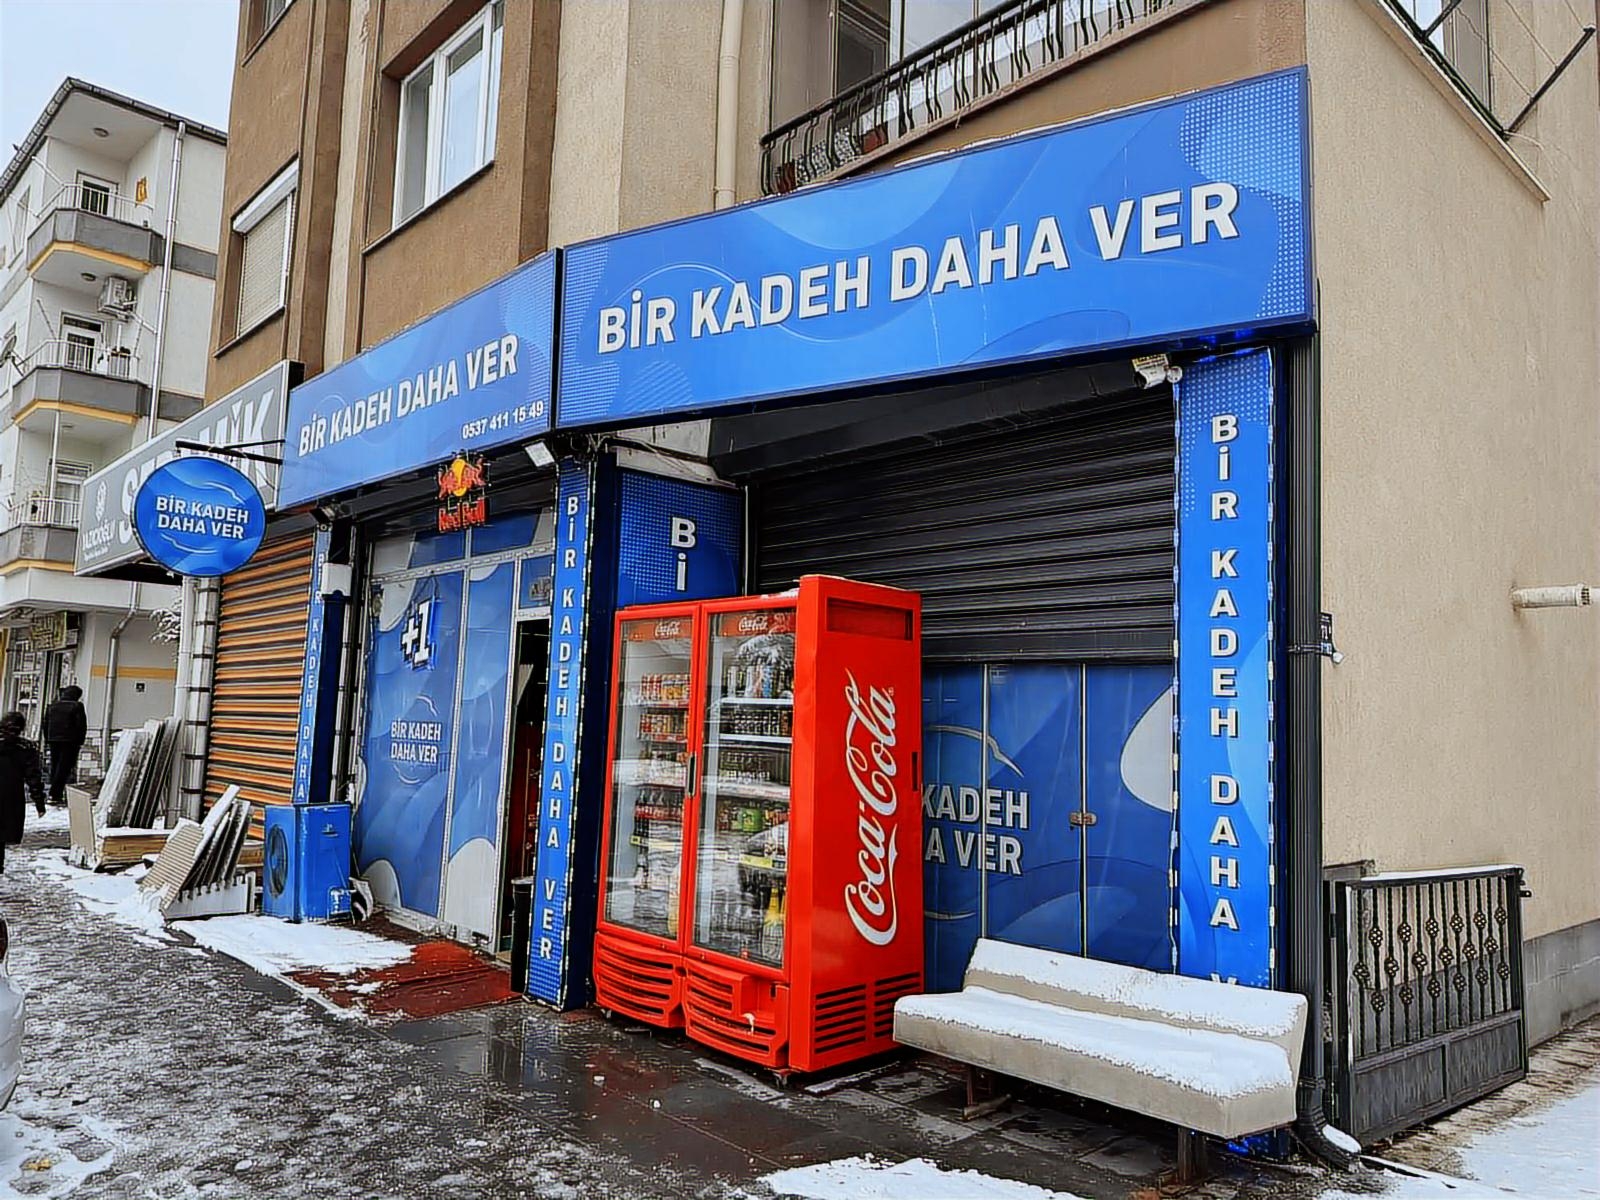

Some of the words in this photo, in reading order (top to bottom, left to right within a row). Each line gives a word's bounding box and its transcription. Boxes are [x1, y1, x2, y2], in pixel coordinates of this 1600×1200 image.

[598, 289, 676, 354] BİR
[691, 256, 870, 338] KADEH
[891, 215, 1070, 301] DAHA
[1090, 182, 1240, 261] VER
[299, 413, 327, 457] BİR
[330, 387, 393, 444] KADEH
[397, 359, 459, 417] DAHA
[466, 334, 518, 391] VER
[462, 418, 488, 439] 0537
[489, 411, 509, 430] 411
[513, 406, 526, 424] 15
[528, 400, 544, 418] 49
[1211, 414, 1239, 520] BİR
[156, 494, 187, 515] BİR
[191, 502, 249, 524] KADEH
[158, 513, 206, 534] DAHA
[211, 521, 244, 539] VER
[564, 496, 579, 568] BİR
[305, 618, 319, 708] KADEH
[556, 589, 575, 716] KADEH
[1209, 550, 1239, 737] KADEH
[298, 725, 310, 799] DAHA
[391, 718, 407, 738] BİR
[408, 722, 441, 741] KADEH
[391, 742, 416, 761] DAHA
[418, 744, 438, 763] VER
[547, 742, 565, 849] DAHA
[845, 667, 898, 946] Coca-Cola
[922, 784, 1028, 829] KADEH
[954, 830, 1021, 875] VER
[1209, 774, 1239, 930] DAHA
[540, 879, 557, 960] VER
